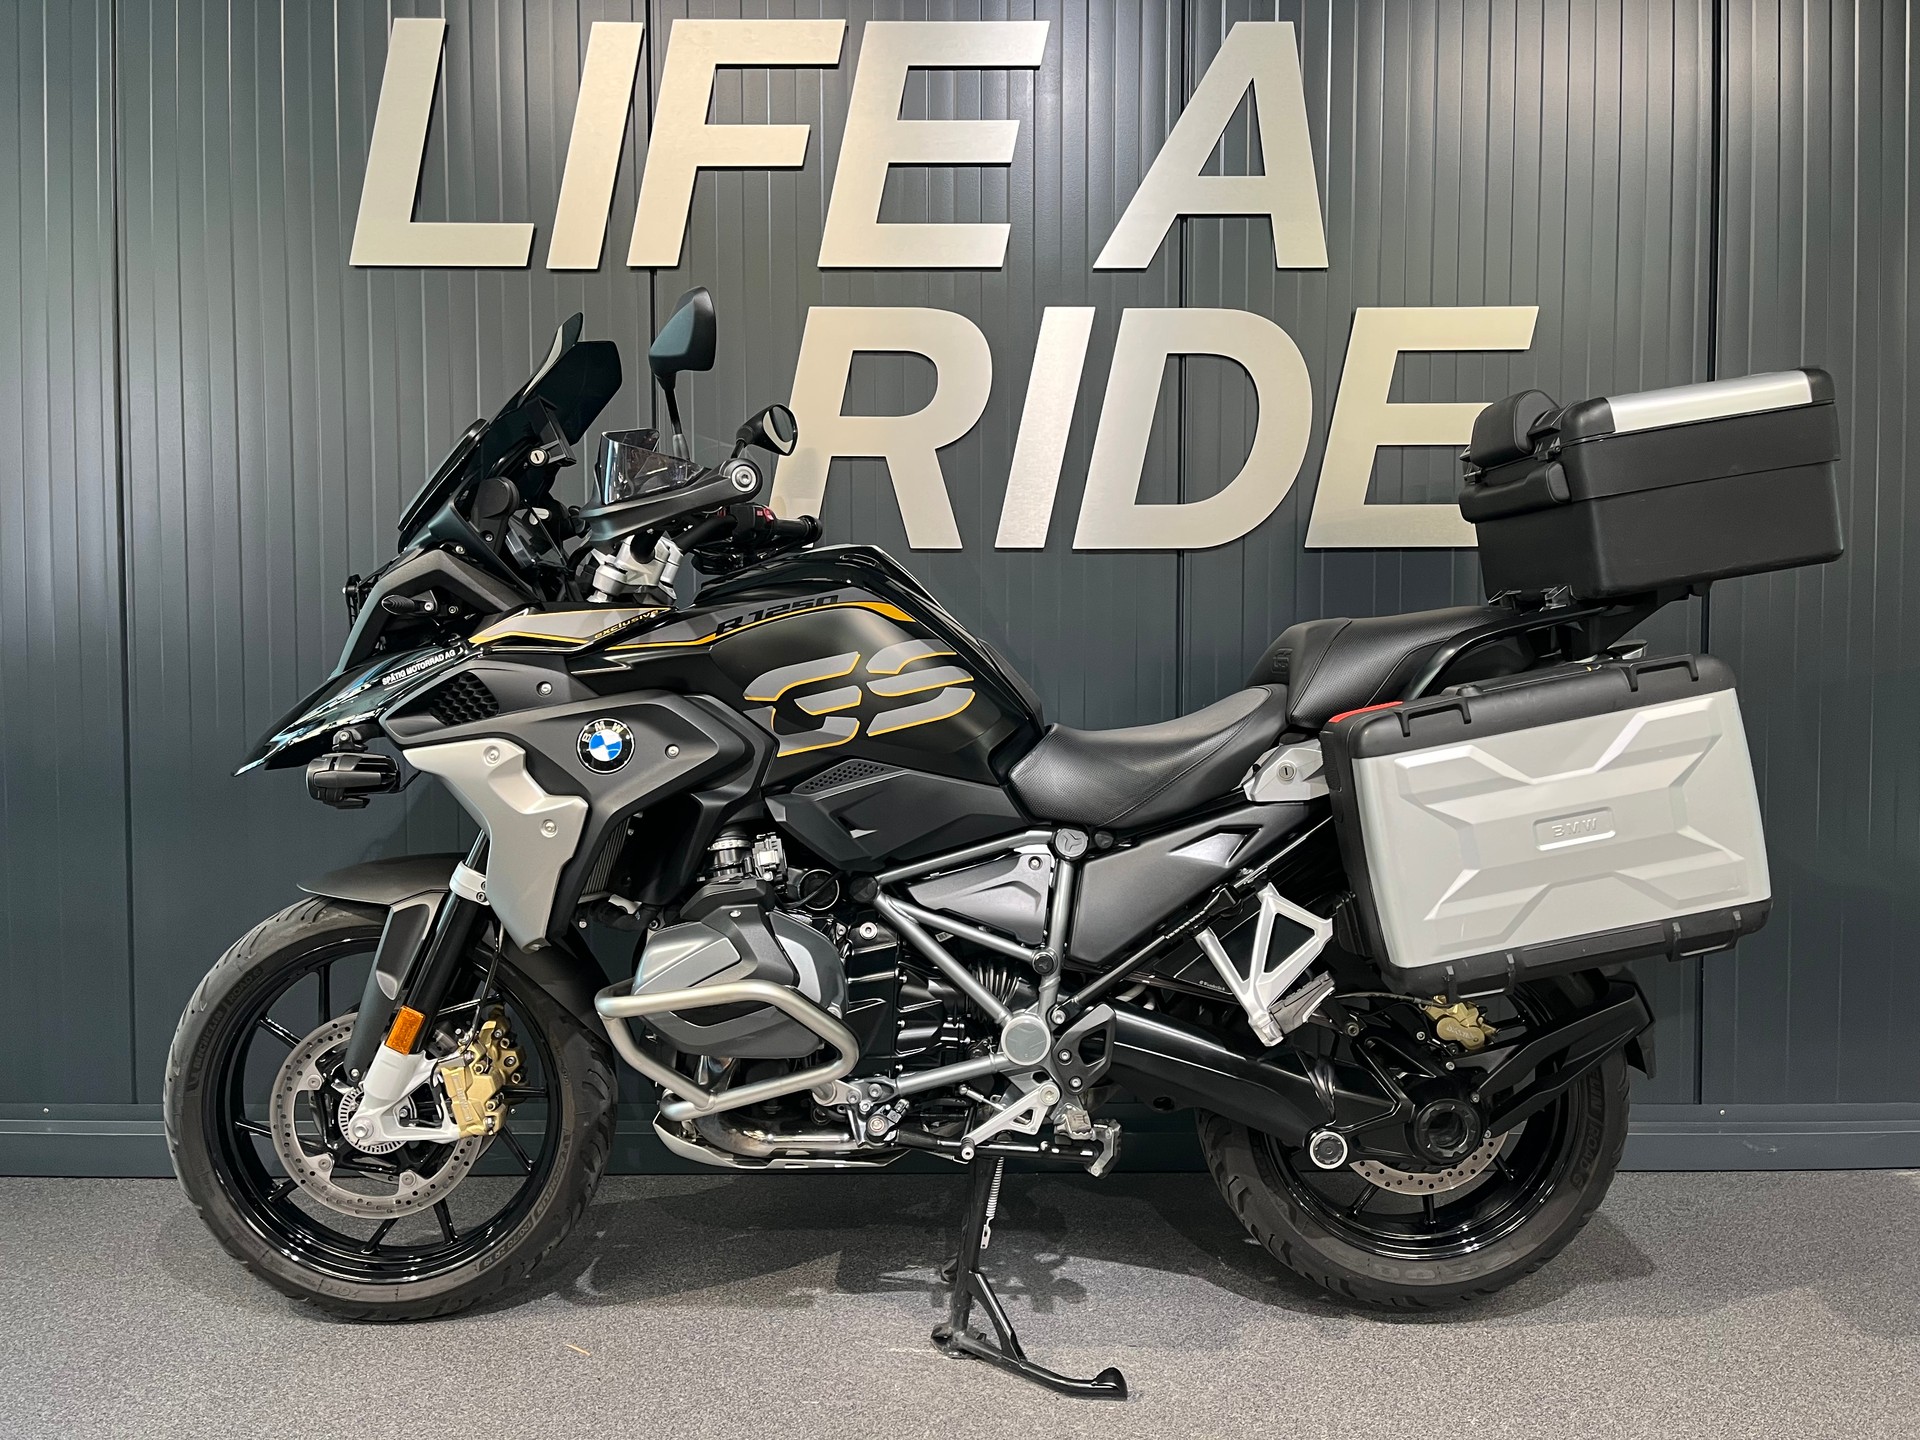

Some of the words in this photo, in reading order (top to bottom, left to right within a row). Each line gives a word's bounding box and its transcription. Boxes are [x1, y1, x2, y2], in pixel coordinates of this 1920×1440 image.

[349, 18, 1051, 270] LIFE
[1093, 20, 1329, 270] A
[768, 305, 1540, 550] RIDE
[406, 653, 445, 675] MOTORRAD
[444, 649, 456, 660] AG
[581, 720, 624, 743] BMW
[743, 639, 976, 758] GS
[1551, 817, 1597, 838] BMW
